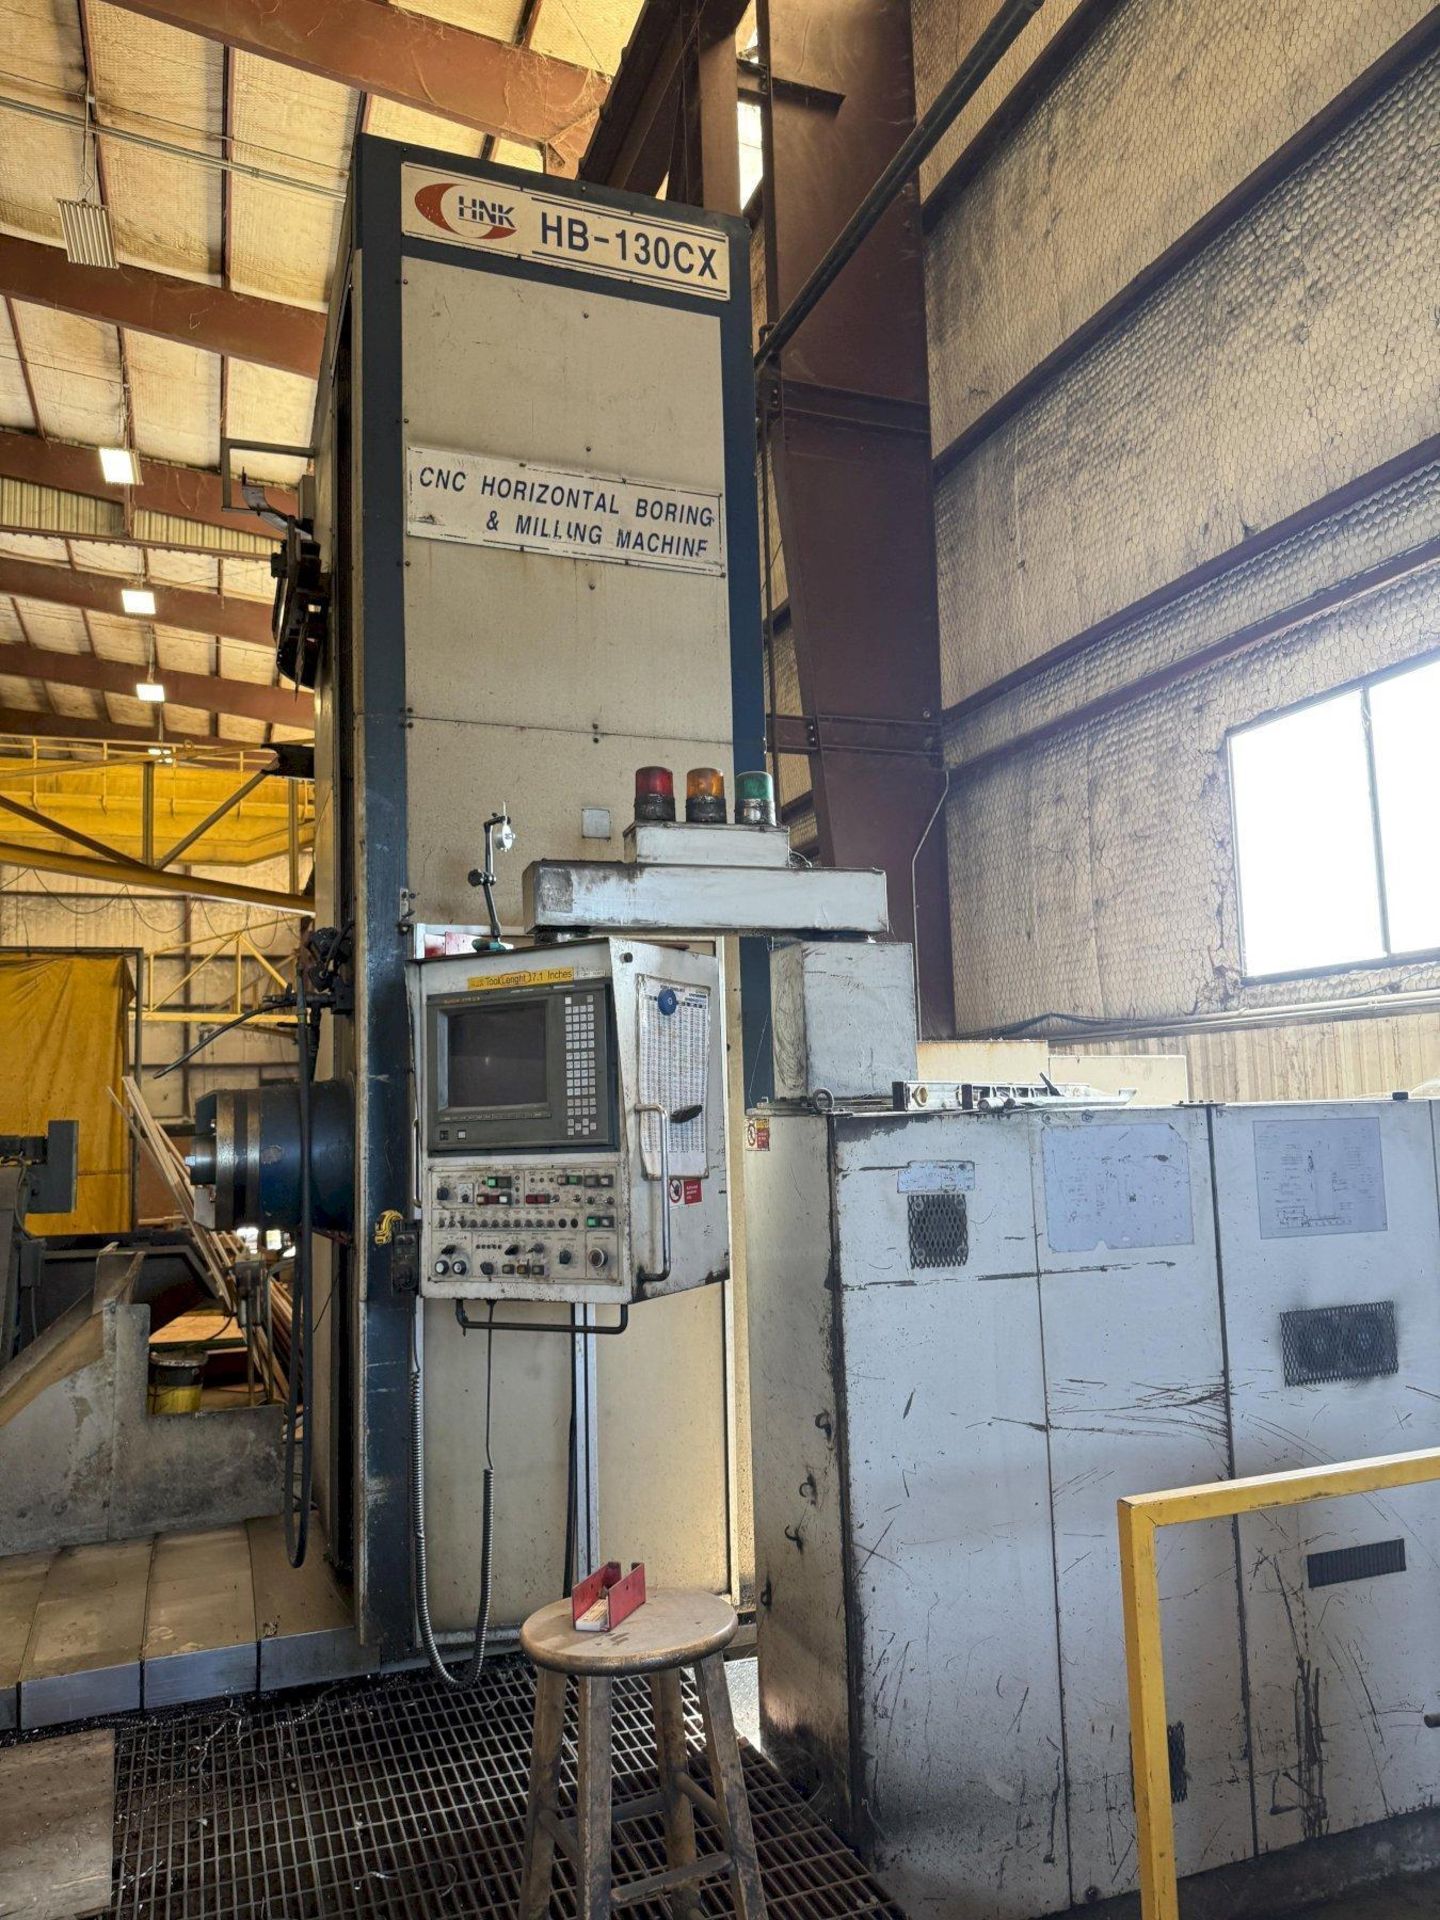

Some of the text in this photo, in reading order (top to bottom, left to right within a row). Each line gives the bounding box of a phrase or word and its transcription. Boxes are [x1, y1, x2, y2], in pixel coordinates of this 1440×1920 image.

[458, 195, 516, 228] HNK
[541, 212, 718, 280] HB-130CX
[419, 466, 715, 527] CNC HORIZONTAL BORING
[486, 510, 499, 531] &
[515, 514, 602, 544] MILLING
